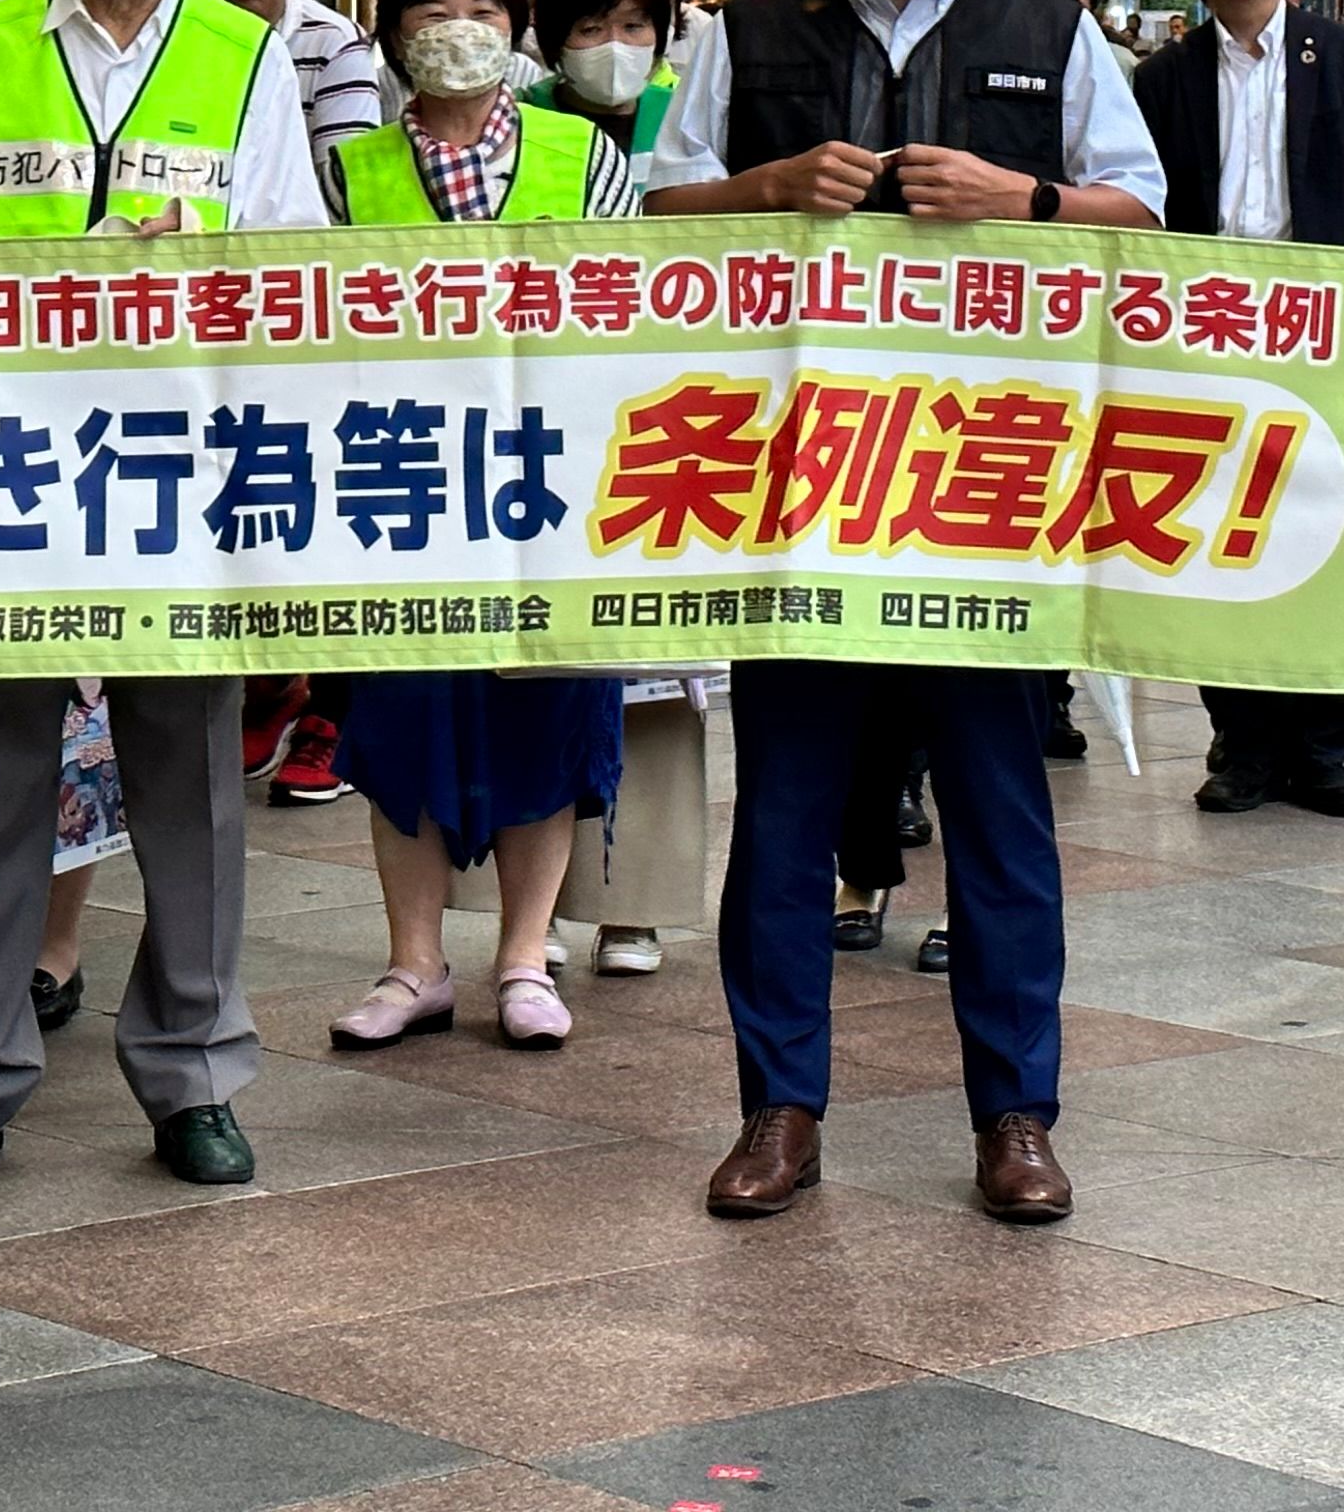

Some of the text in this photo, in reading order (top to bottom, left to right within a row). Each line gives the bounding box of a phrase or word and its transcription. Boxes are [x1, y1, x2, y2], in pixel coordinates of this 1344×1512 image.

[987, 72, 1047, 91] 四日市市
[591, 586, 845, 629] 四日市南警察署
[882, 591, 1030, 635] 四日市市
